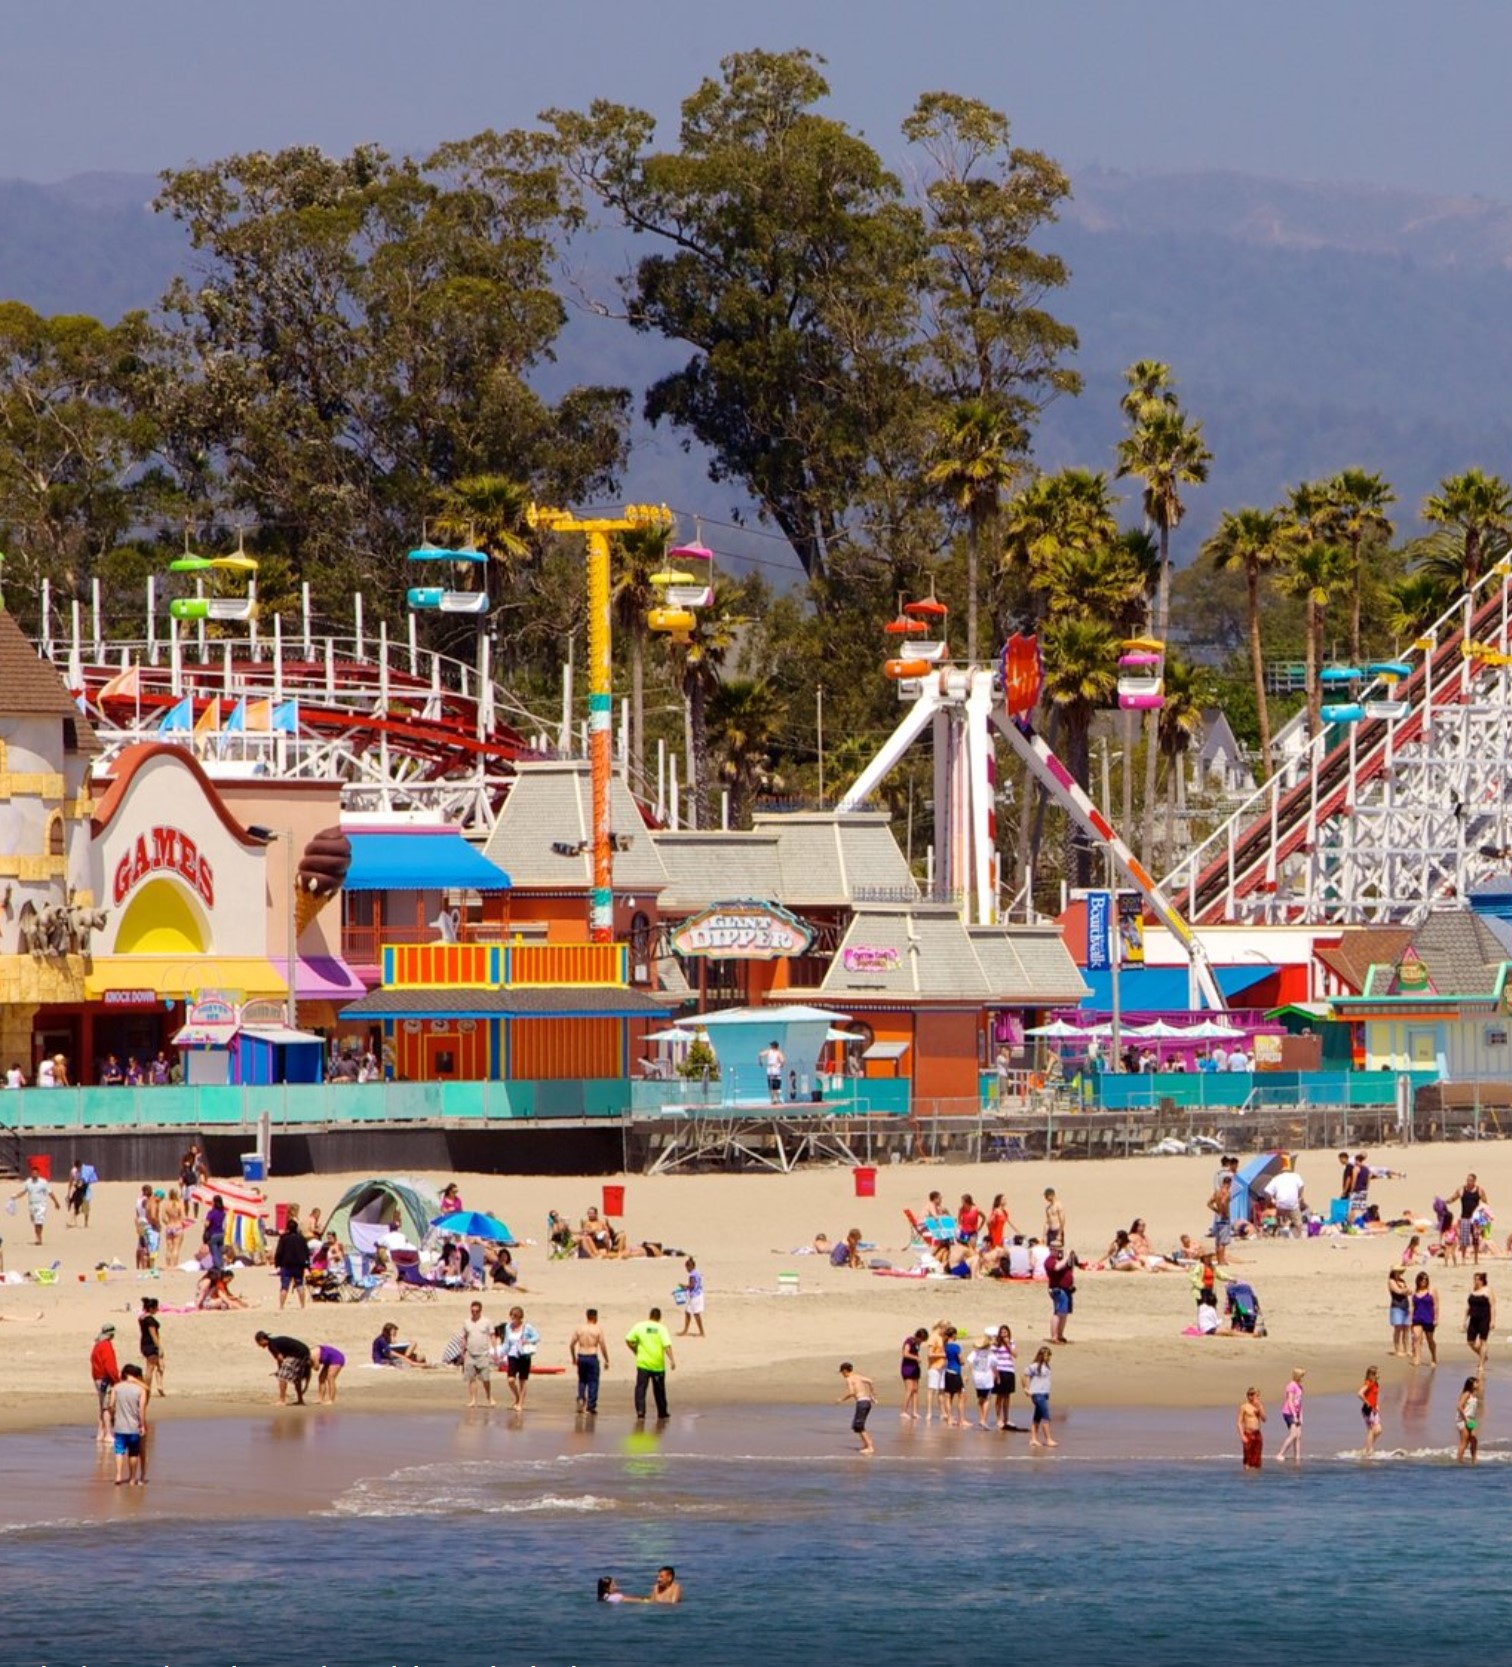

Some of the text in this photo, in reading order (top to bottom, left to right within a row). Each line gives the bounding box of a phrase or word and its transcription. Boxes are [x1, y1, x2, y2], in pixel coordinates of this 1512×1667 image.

[113, 825, 214, 910] GAMES
[689, 927, 793, 949] DIPPER
[709, 915, 772, 929] GIANT
[1089, 896, 1106, 968] Boardwalk
